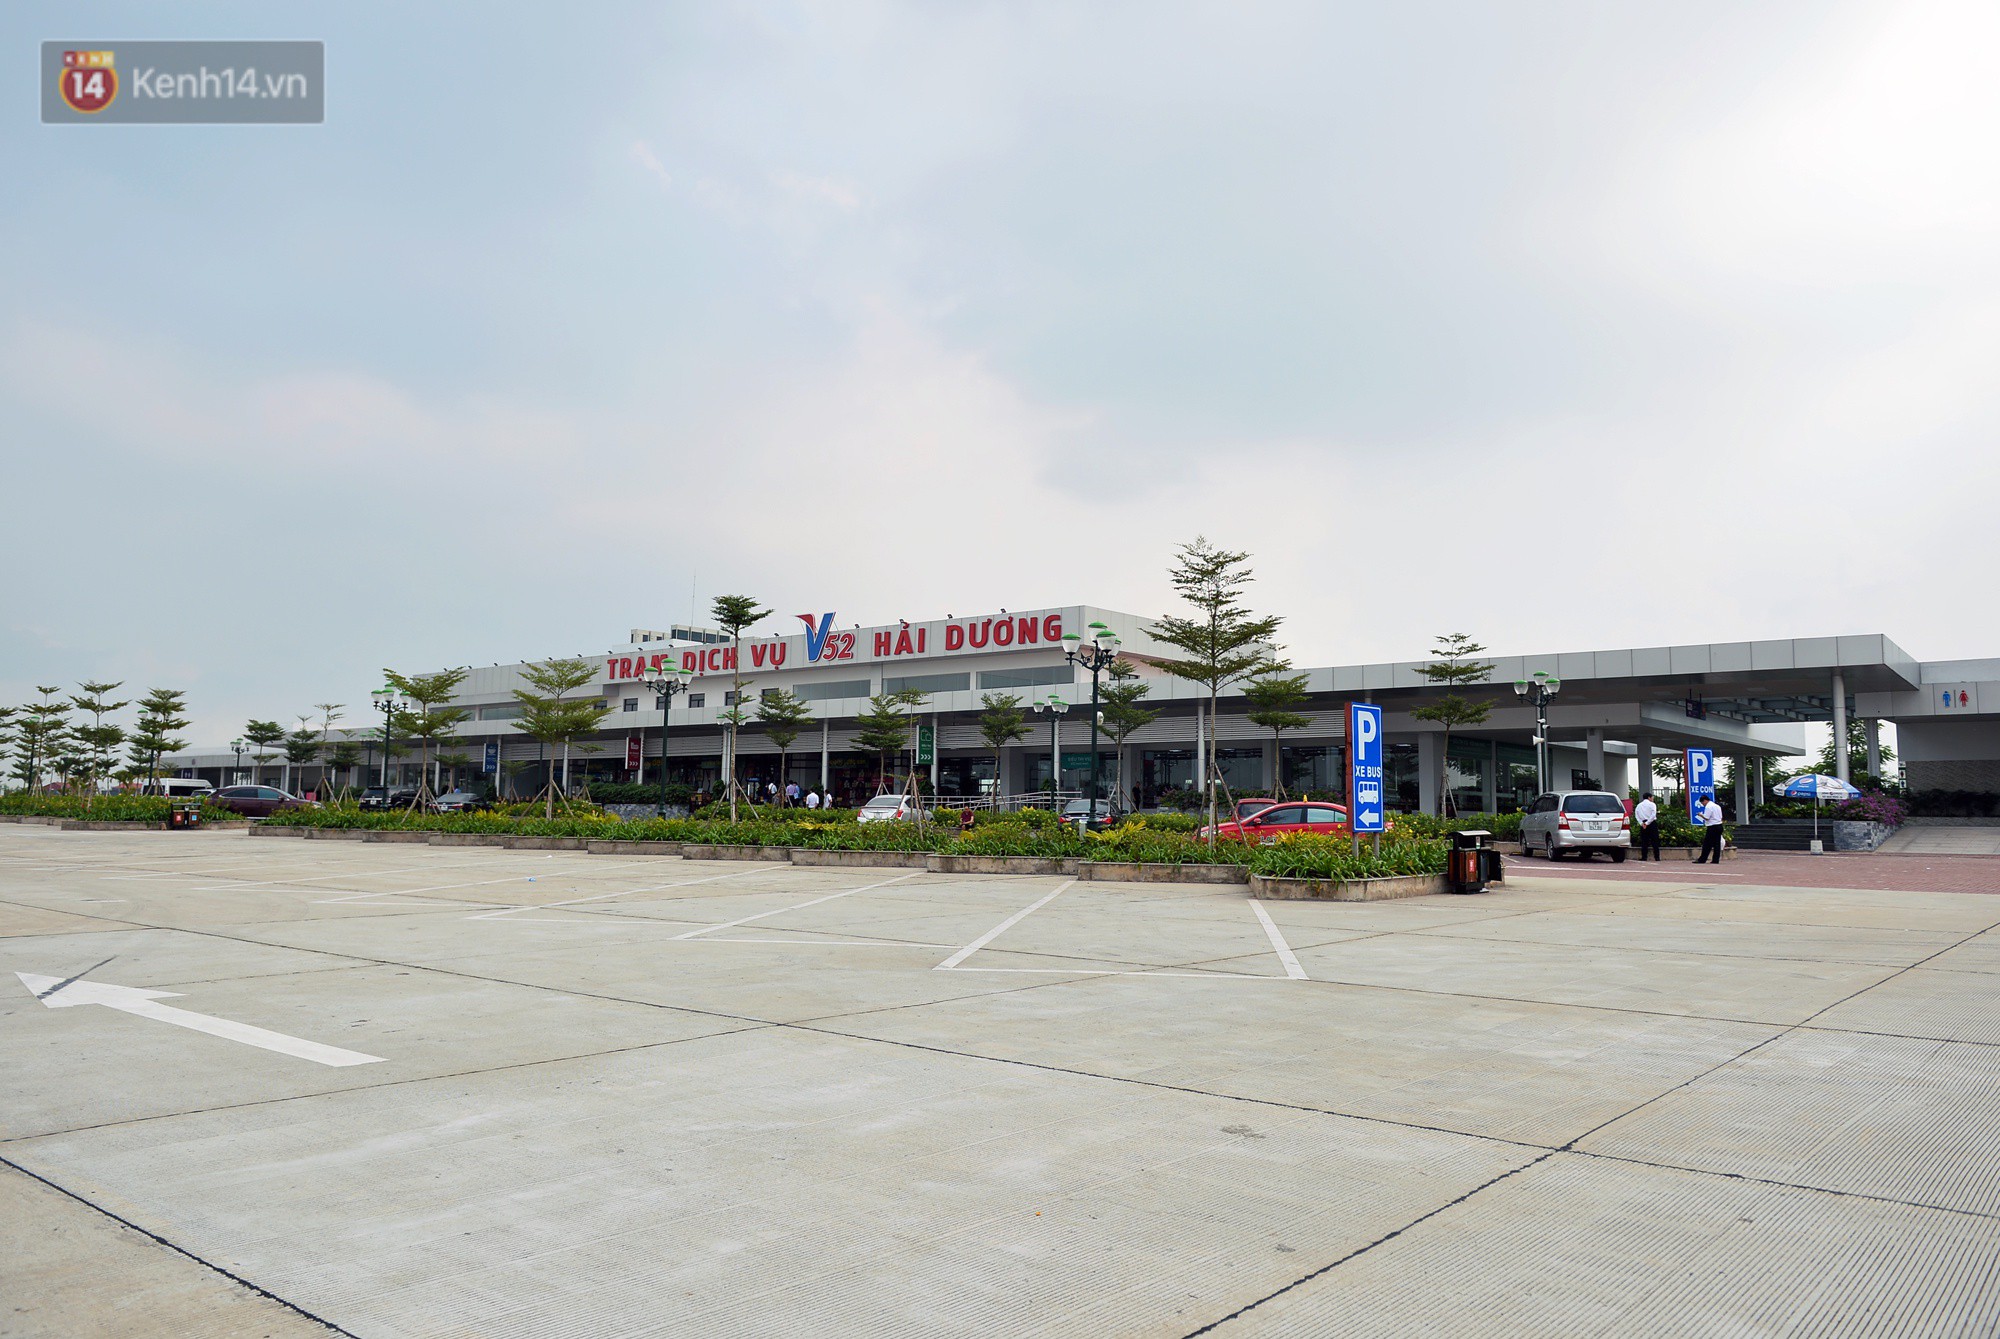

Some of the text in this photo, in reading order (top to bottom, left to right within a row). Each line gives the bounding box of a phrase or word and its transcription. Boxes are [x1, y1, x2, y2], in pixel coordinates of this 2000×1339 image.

[682, 647, 737, 677] DỊCH
[750, 641, 787, 670] VỤ
[874, 621, 926, 658] HẢI
[945, 614, 1062, 651] DƯƠNG
[1357, 710, 1377, 760] P
[1355, 765, 1381, 778] XE BUS
[1692, 753, 1708, 783] P
